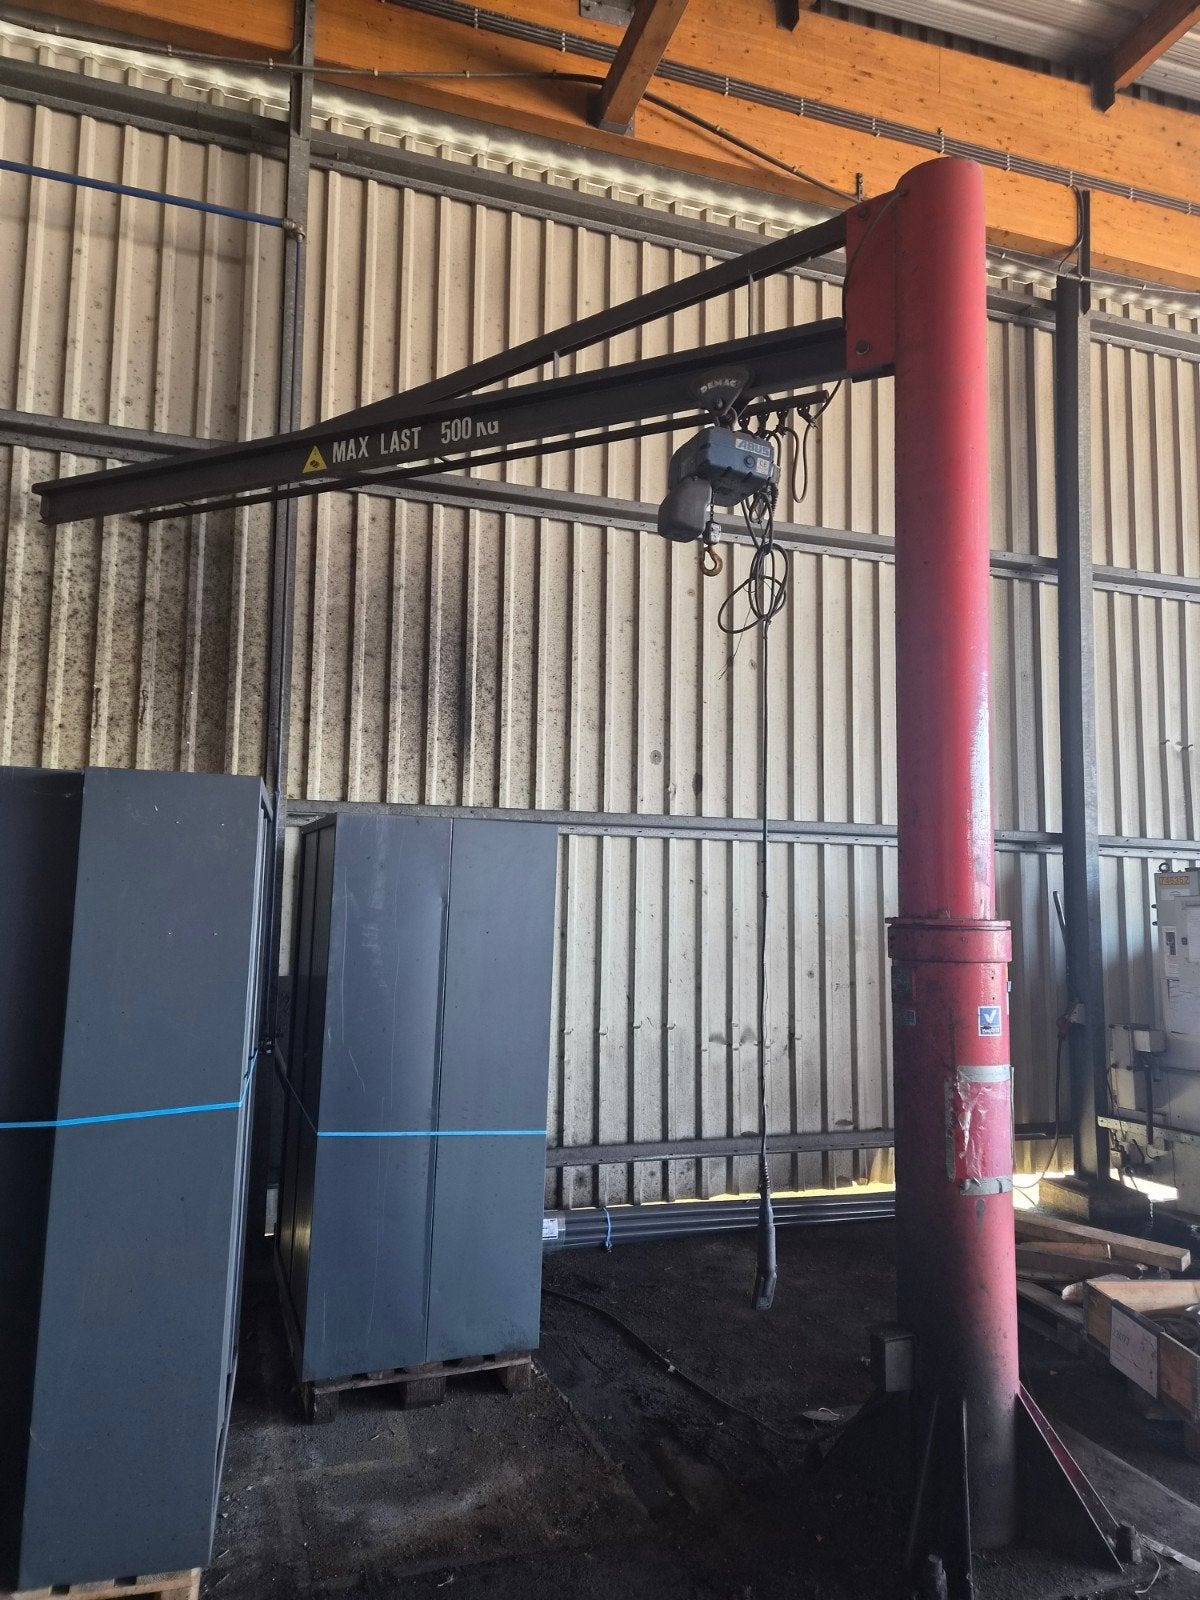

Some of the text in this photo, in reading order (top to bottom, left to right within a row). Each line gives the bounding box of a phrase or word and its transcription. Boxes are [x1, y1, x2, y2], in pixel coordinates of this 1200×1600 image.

[332, 436, 369, 464] MAX
[380, 426, 422, 455] LAST
[441, 416, 472, 444] 500
[739, 440, 771, 456] ABUS
